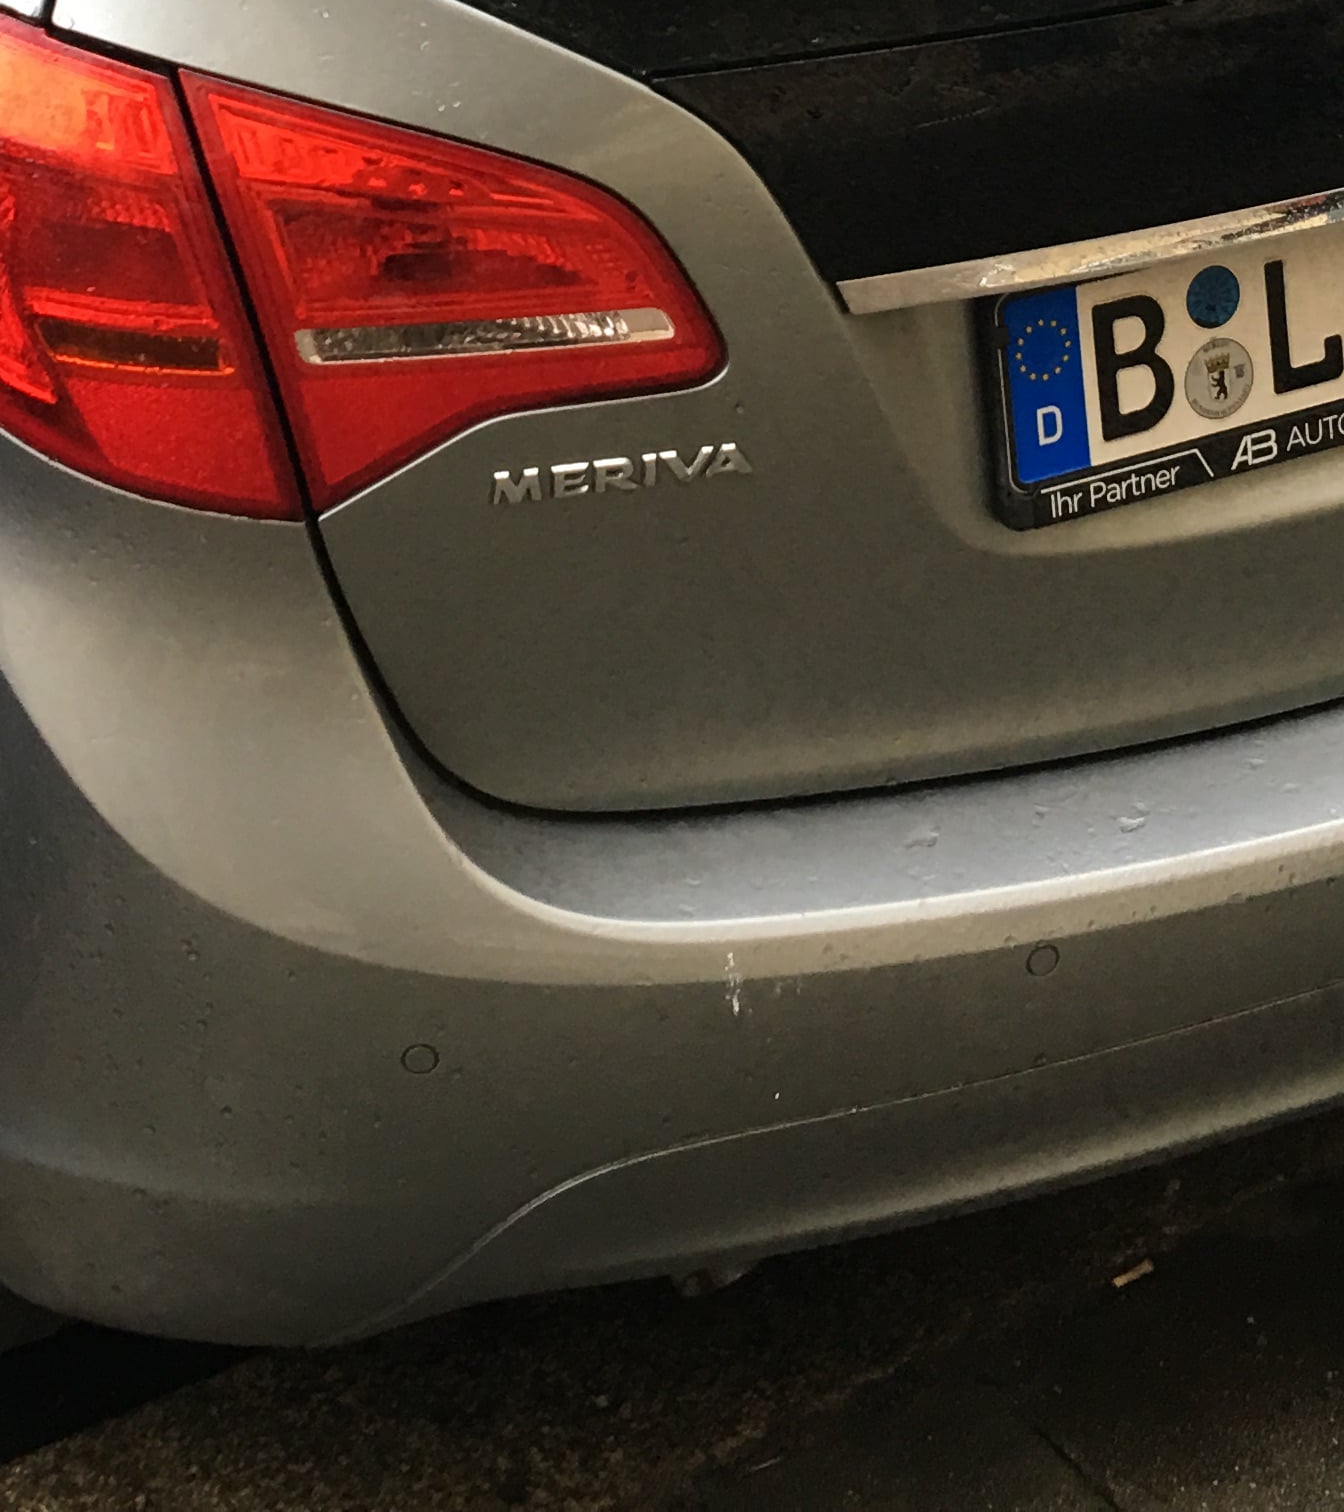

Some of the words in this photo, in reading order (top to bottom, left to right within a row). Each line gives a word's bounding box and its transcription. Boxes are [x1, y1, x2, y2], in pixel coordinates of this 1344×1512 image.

[1091, 294, 1175, 442] B
[1036, 405, 1063, 446] D
[491, 442, 753, 505] MERIVA
[1050, 489, 1082, 519] Ihr
[1089, 465, 1181, 508] Partner
